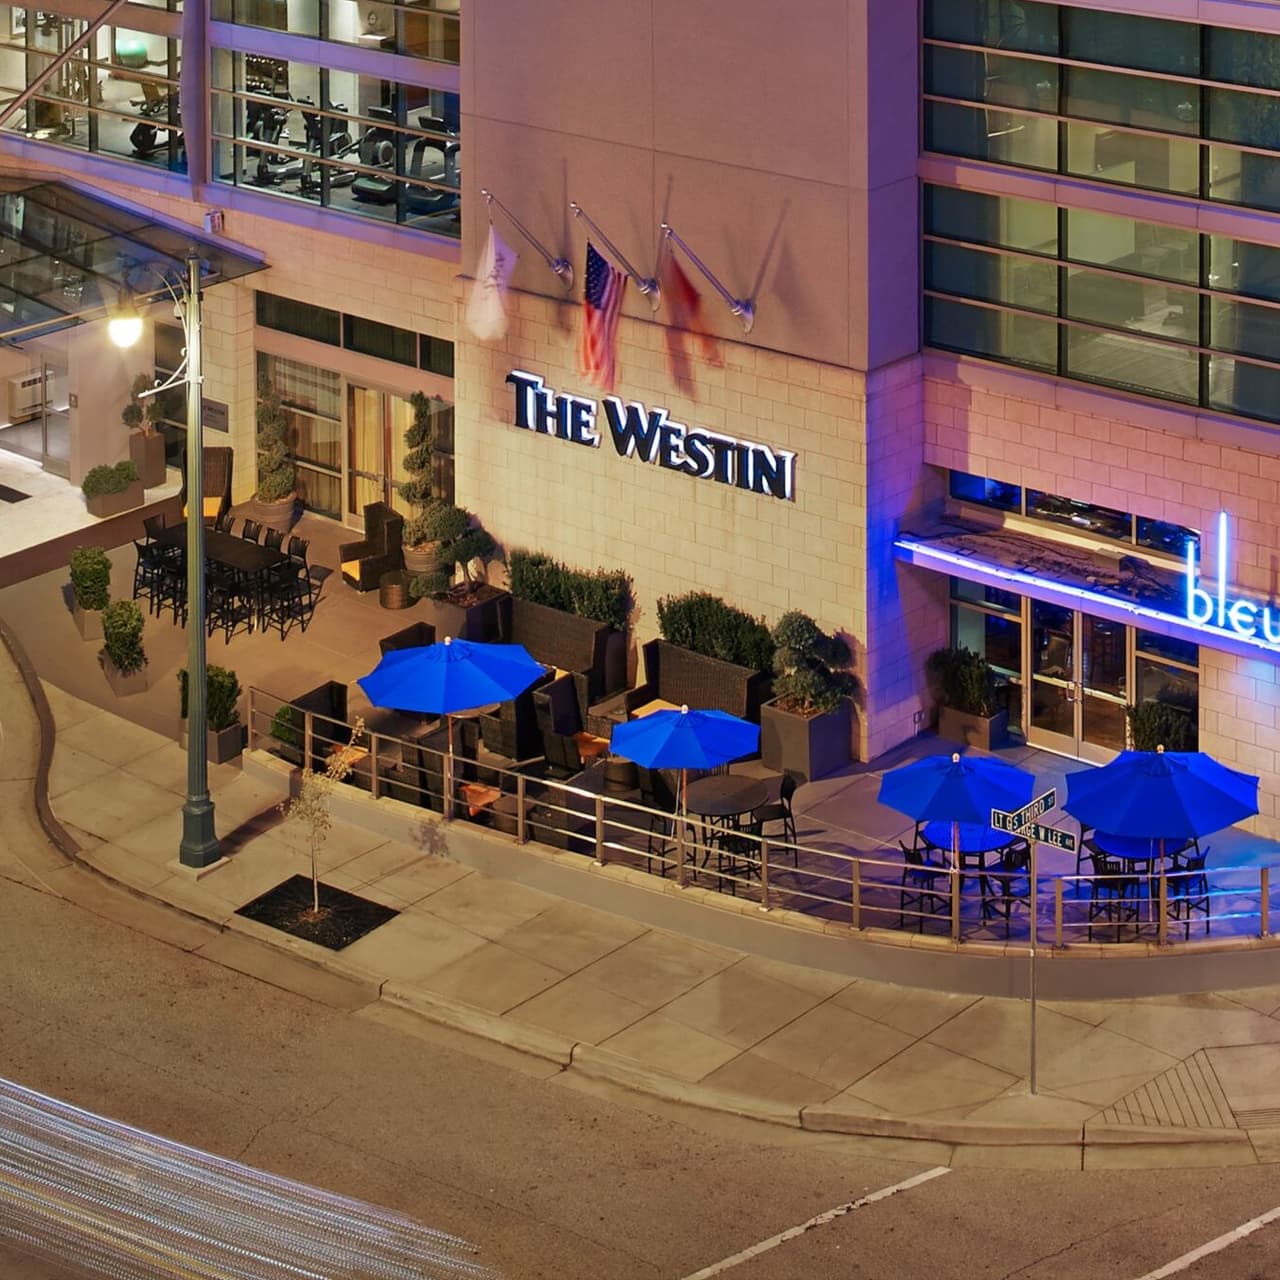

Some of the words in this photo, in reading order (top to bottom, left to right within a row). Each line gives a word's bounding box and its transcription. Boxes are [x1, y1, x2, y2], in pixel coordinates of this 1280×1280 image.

[506, 369, 600, 448] THE
[602, 394, 798, 502] WESTIN
[1021, 799, 1045, 825] THIRD
[994, 813, 1003, 828] LT
[1048, 829, 1062, 846] LEE
